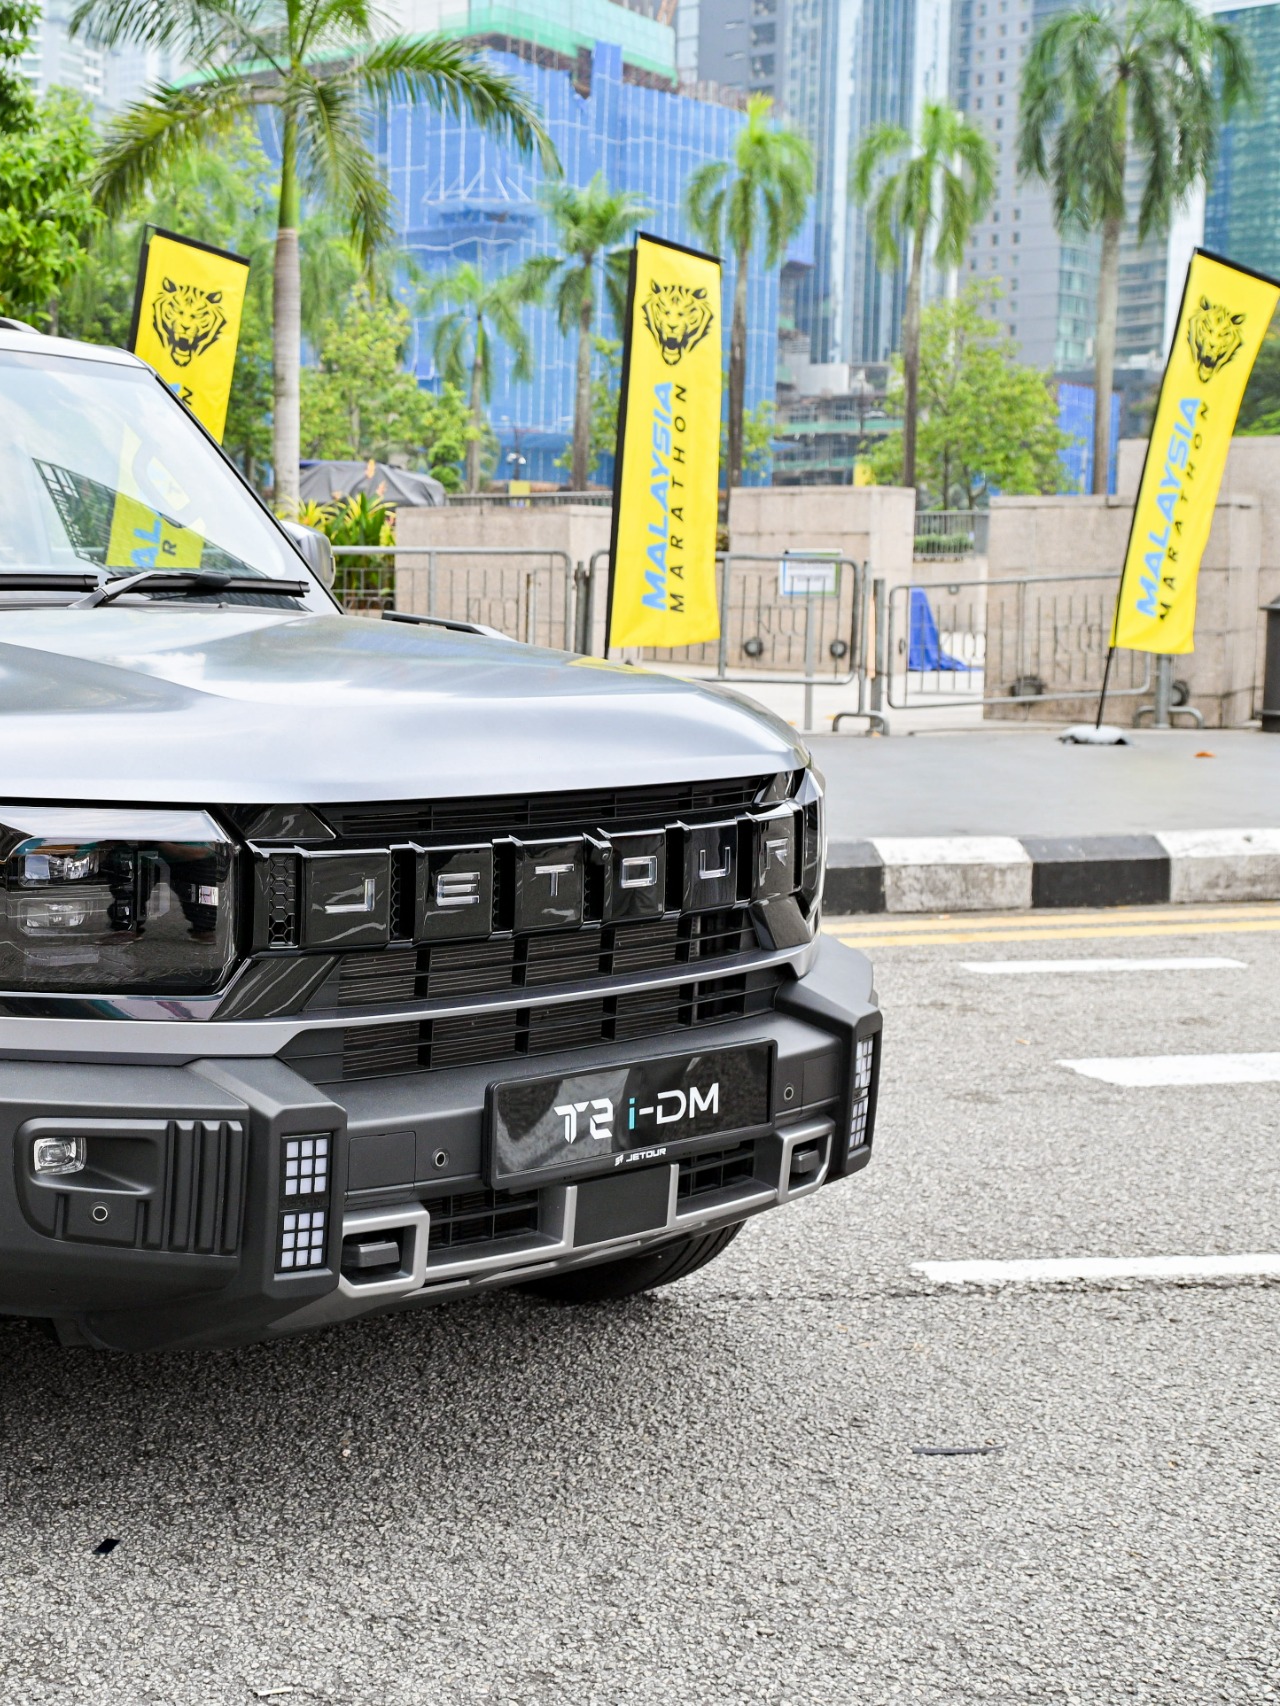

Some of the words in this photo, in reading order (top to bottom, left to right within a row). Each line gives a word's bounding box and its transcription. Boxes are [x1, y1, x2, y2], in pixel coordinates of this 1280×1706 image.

[641, 382, 672, 611] MALAYSIA
[670, 384, 687, 613] MARATHON
[1136, 398, 1201, 618] MALAYSIA
[1159, 402, 1209, 622] MARATHON
[323, 837, 789, 914] JETOUR
[553, 1097, 614, 1144] T2
[628, 1082, 719, 1130] i-DM
[626, 1147, 667, 1163] JETOUR
